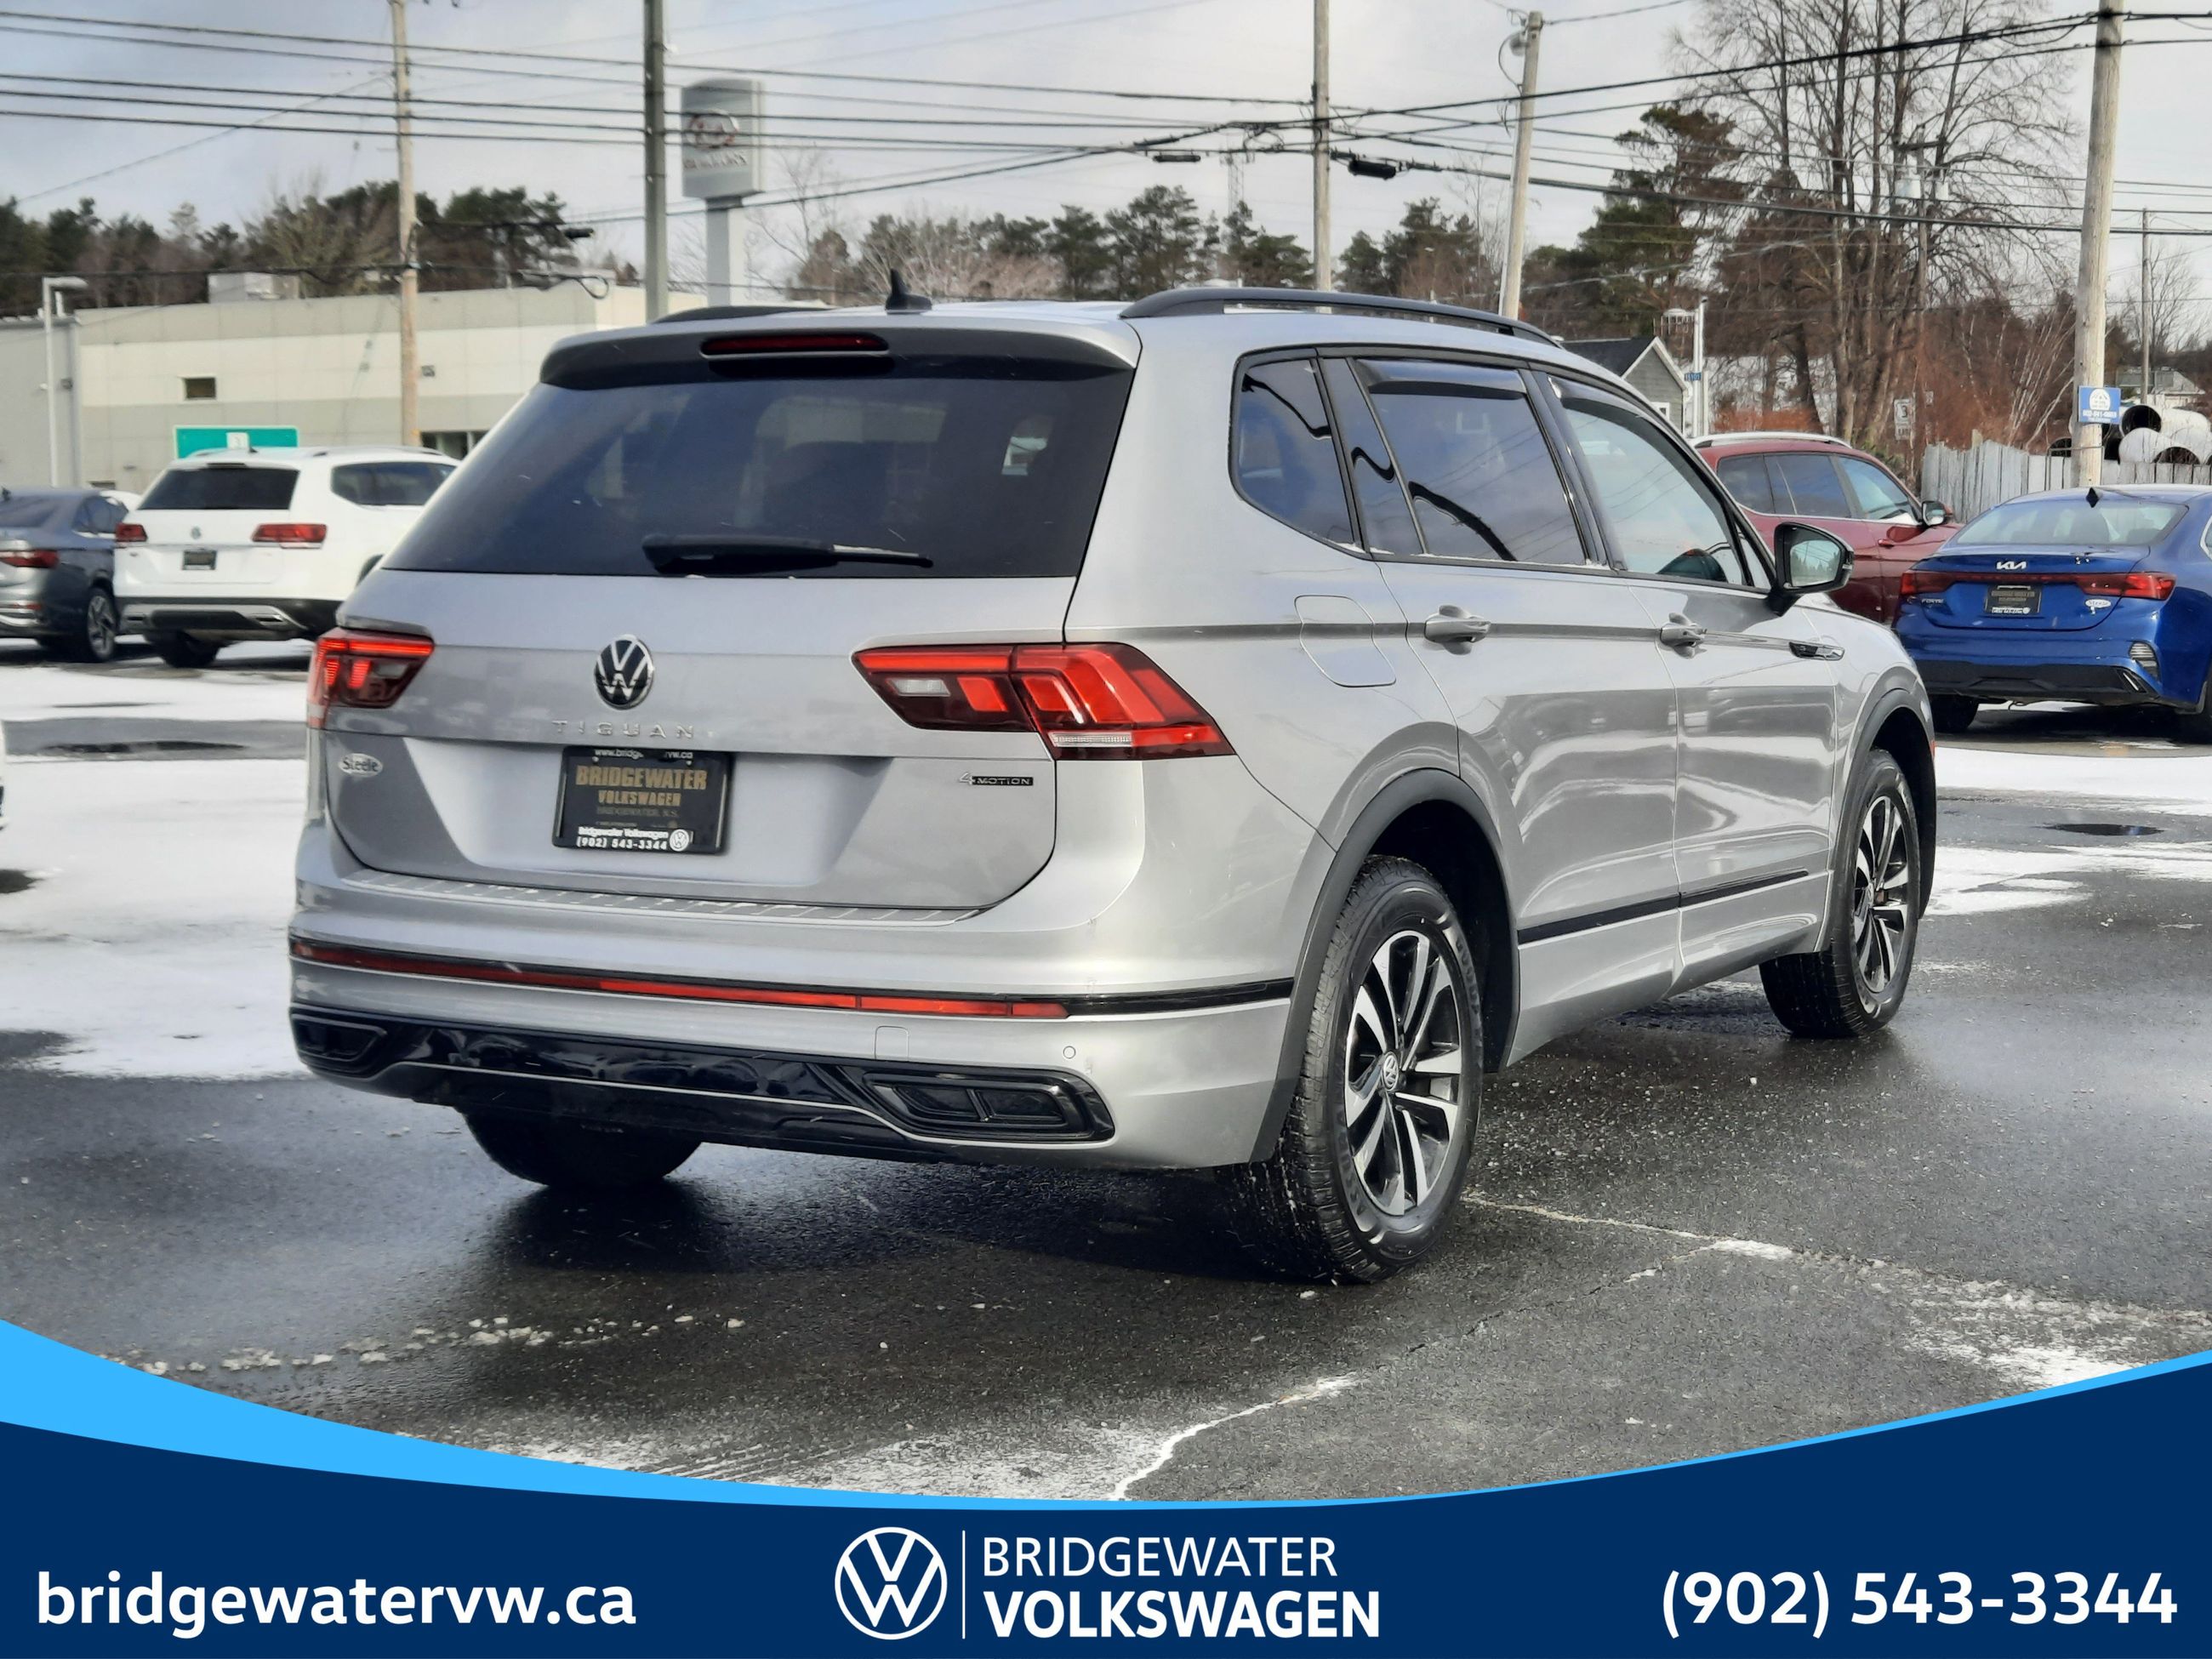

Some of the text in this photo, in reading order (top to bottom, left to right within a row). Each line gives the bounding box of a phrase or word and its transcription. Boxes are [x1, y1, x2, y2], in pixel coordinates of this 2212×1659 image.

[1996, 561, 2027, 570] KIA
[551, 720, 694, 739] TIGUAN
[575, 764, 708, 790] BRIDGEWATER
[597, 790, 682, 807] VOLKSWAGEN
[576, 836, 668, 852] (902) 543-3344
